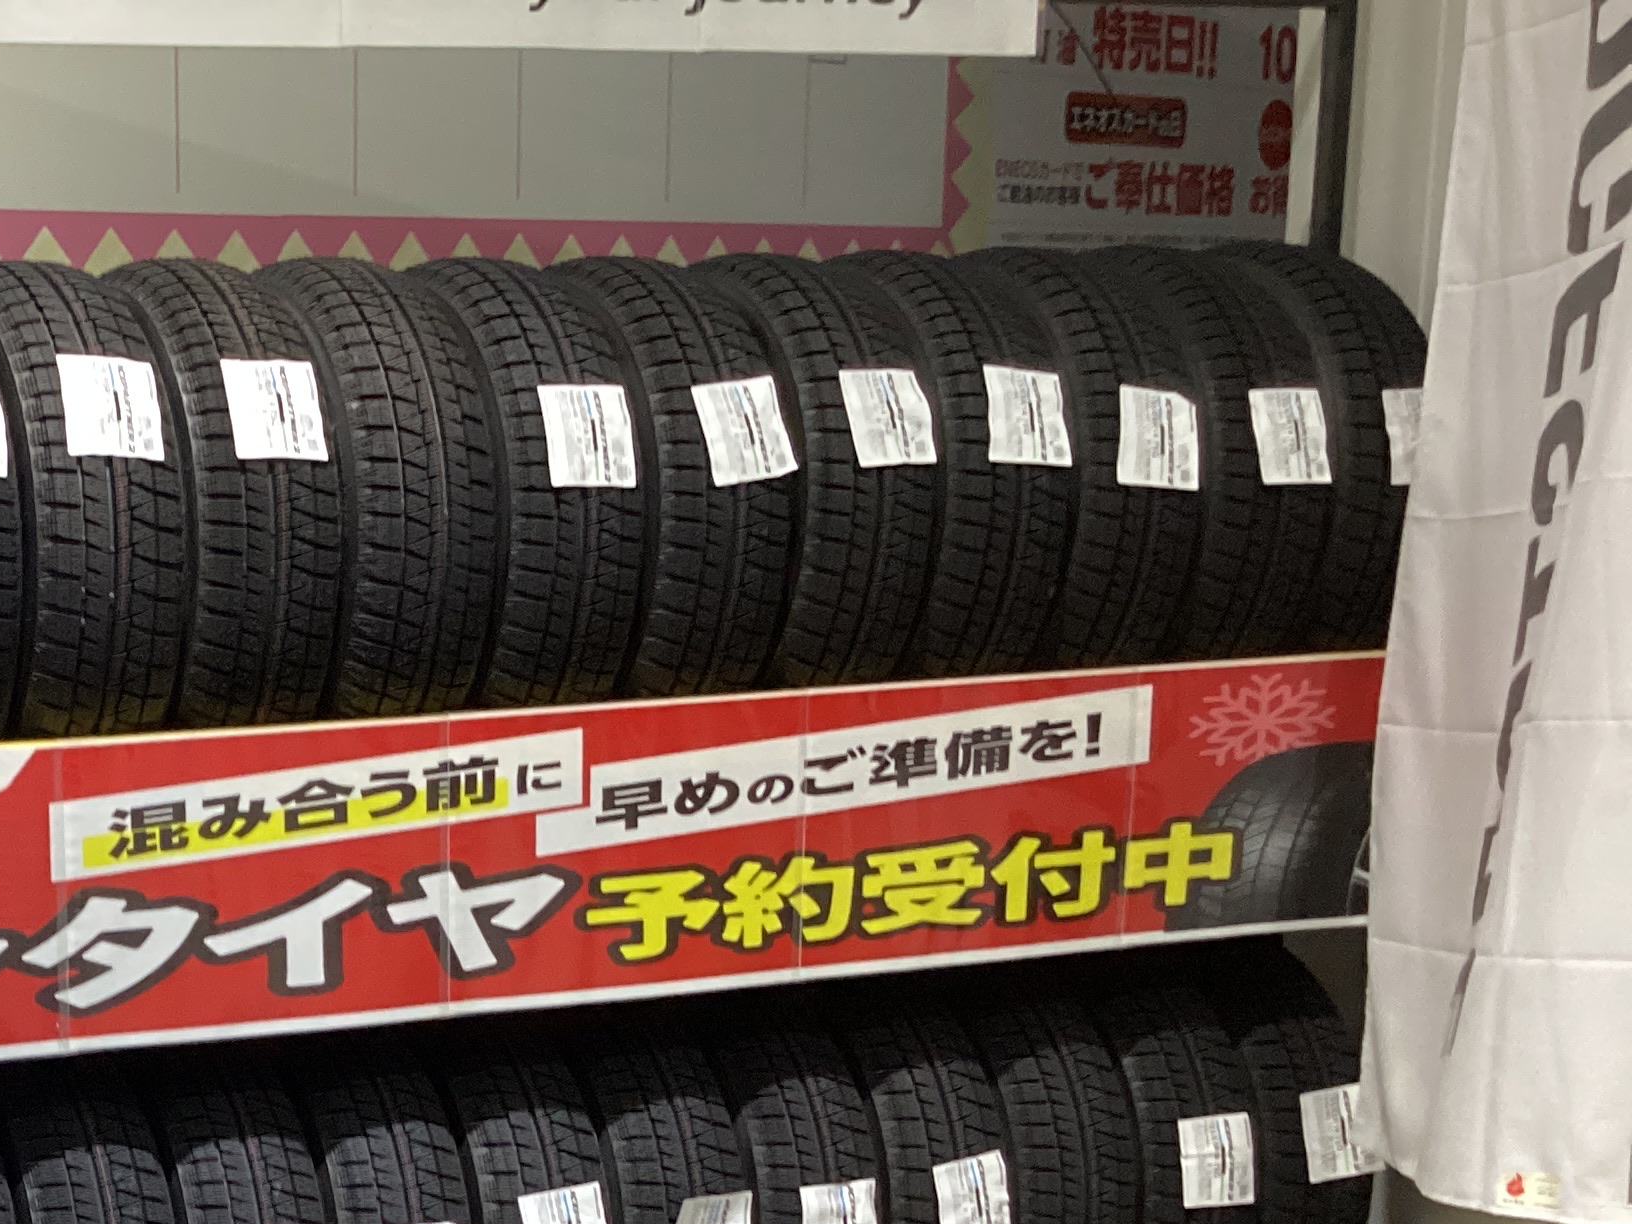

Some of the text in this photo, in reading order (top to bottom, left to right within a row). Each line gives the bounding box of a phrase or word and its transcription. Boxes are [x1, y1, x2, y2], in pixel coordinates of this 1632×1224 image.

[108, 755, 564, 859] 混み合う前に
